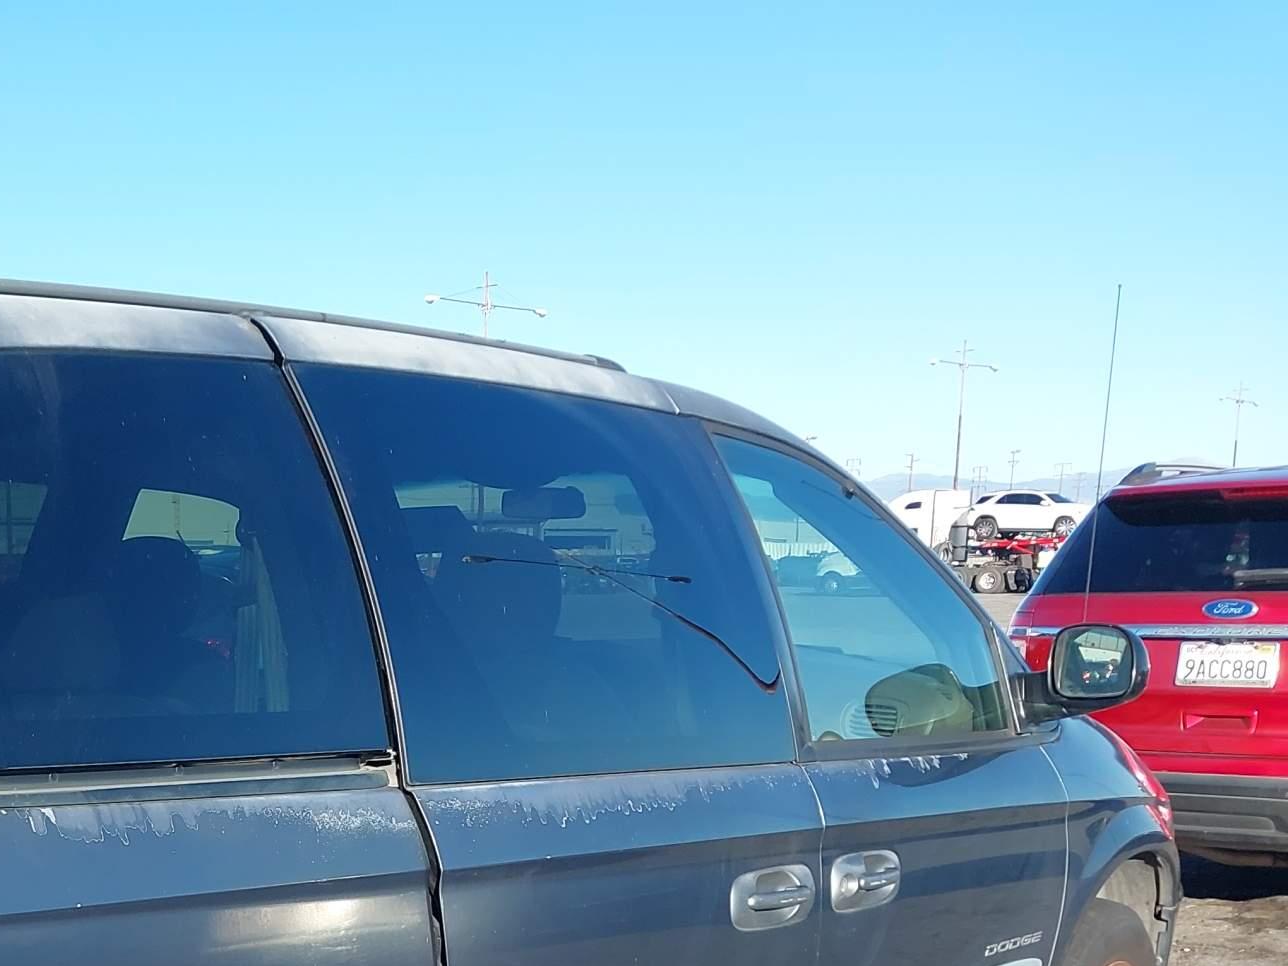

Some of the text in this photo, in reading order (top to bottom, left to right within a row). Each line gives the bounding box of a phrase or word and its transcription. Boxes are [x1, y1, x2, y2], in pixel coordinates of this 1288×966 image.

[1213, 602, 1245, 615] Ford
[1183, 659, 1268, 680] 9ACC880
[984, 930, 1043, 957] DODGE
